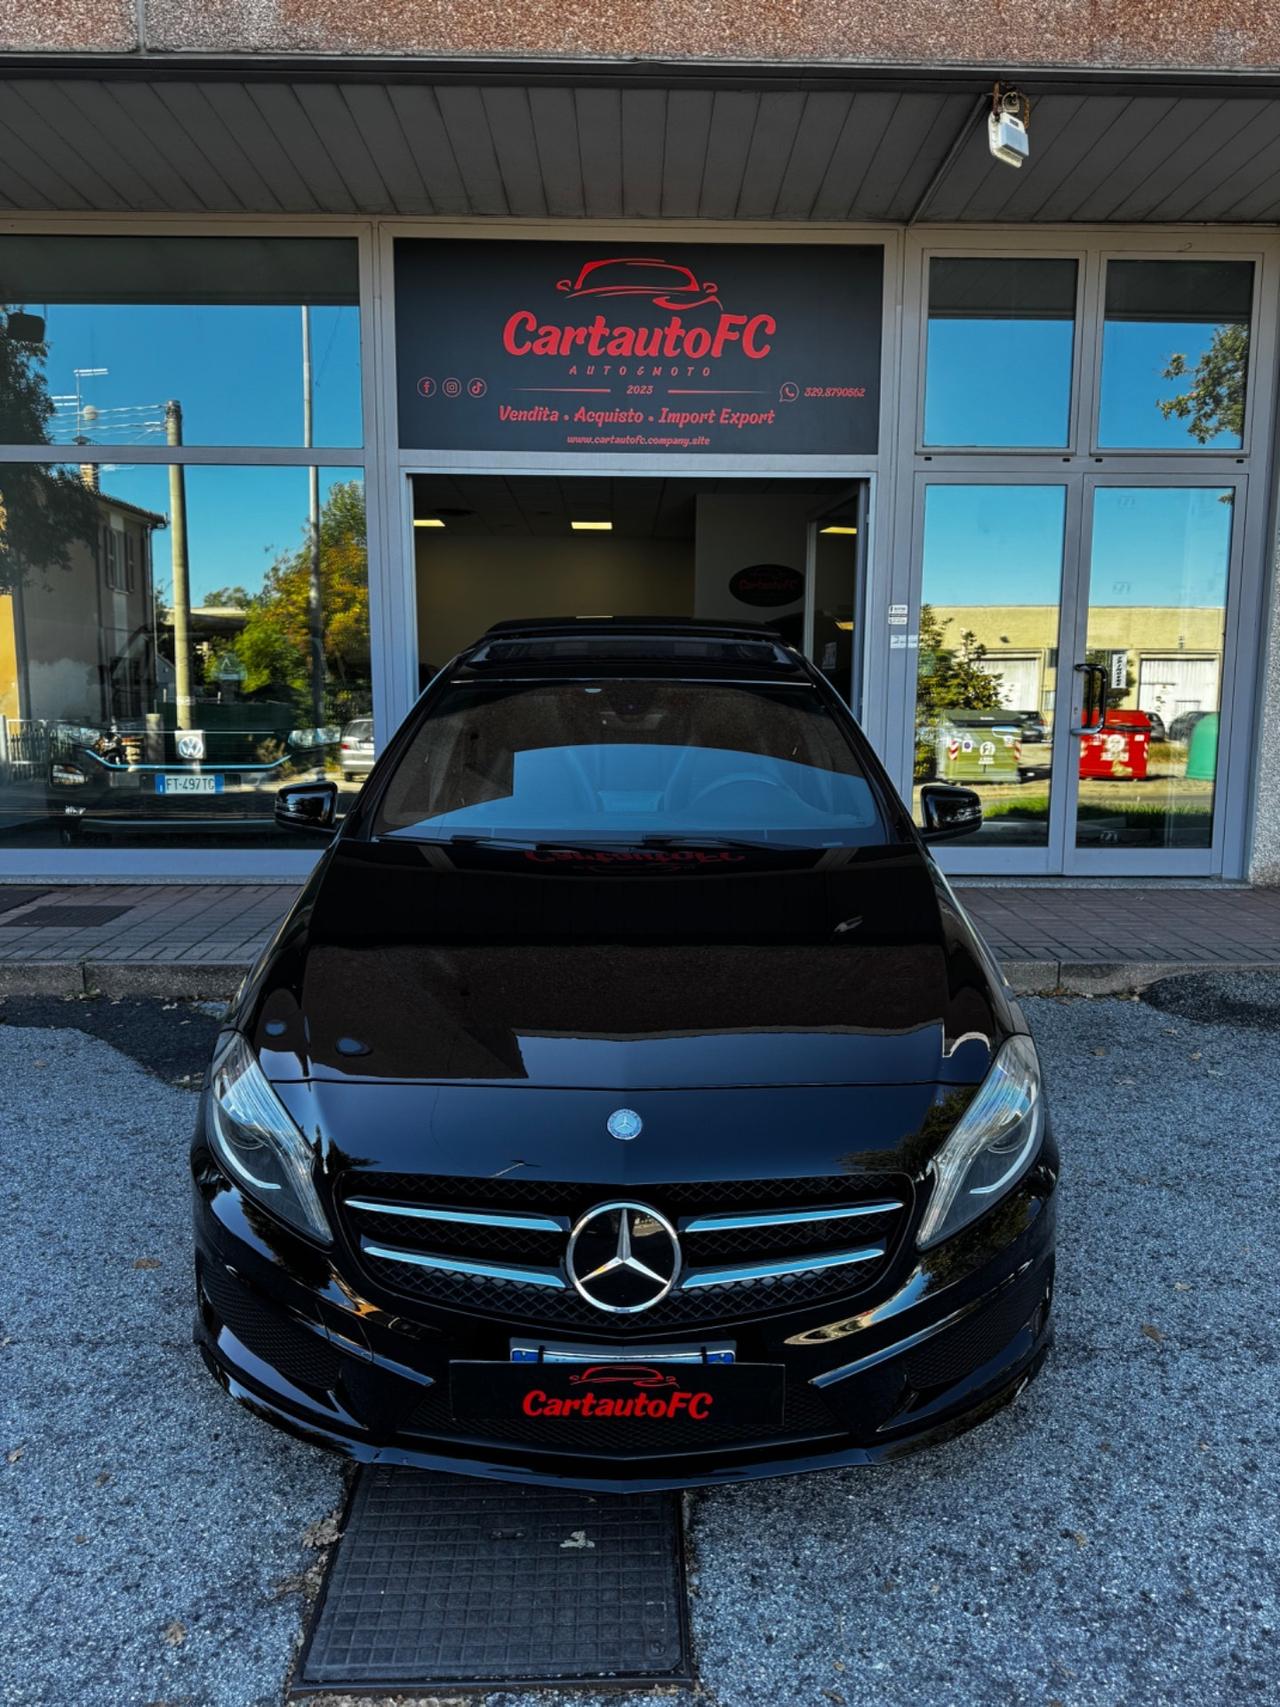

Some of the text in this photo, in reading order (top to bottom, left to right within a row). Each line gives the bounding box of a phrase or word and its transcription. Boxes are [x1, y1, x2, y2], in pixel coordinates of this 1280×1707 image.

[502, 310, 777, 359] CartautoFC
[626, 384, 654, 395] 2023
[499, 405, 776, 428] Vendita Acquisto Import Export
[567, 434, 711, 447] www.cartautofc.company.site
[522, 1389, 713, 1420] CartautoFC
